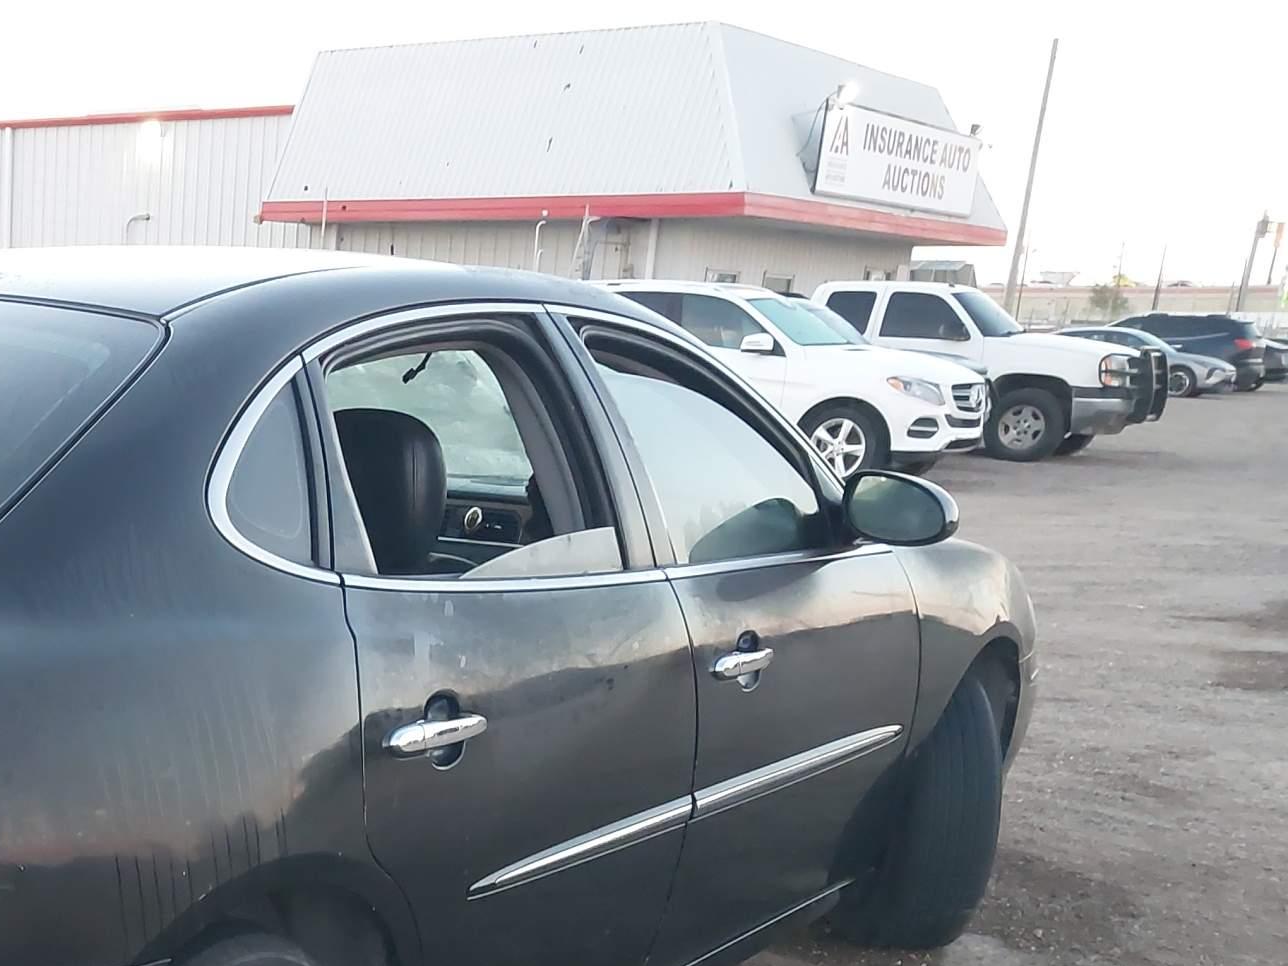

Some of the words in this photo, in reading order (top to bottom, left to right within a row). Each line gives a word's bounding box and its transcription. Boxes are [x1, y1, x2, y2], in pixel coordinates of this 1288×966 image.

[863, 123, 938, 165] INSURANCE
[939, 143, 971, 172] AUTO
[882, 163, 946, 200] AUCTIONS
